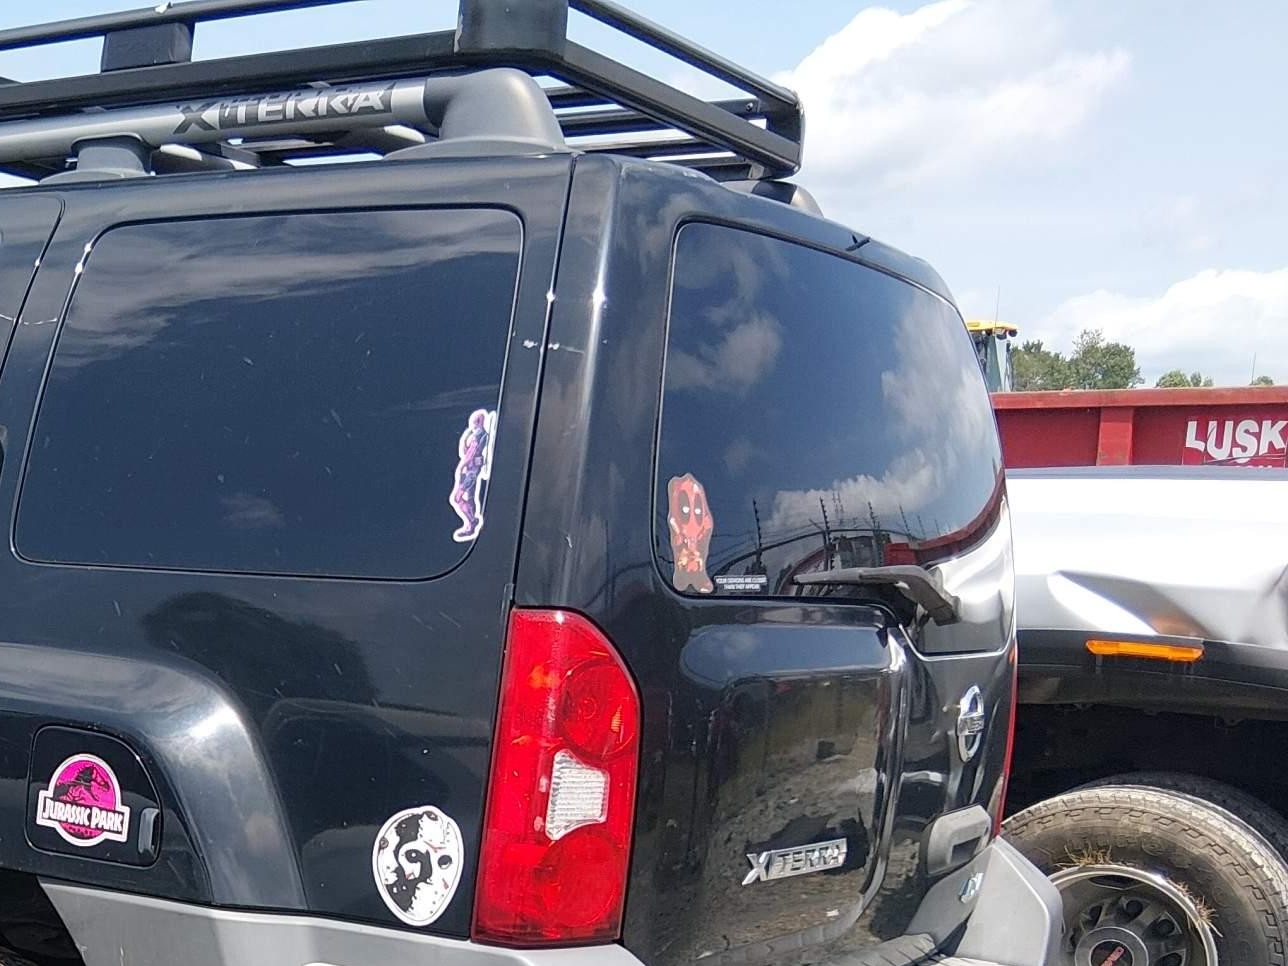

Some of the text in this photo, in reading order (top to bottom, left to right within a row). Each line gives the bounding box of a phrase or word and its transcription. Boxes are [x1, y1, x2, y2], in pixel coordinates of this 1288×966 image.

[173, 82, 393, 134] XTERRA
[1186, 420, 1288, 464] LUSK
[43, 798, 124, 832] JURASSIC PARK
[742, 838, 847, 886] XTERRA
